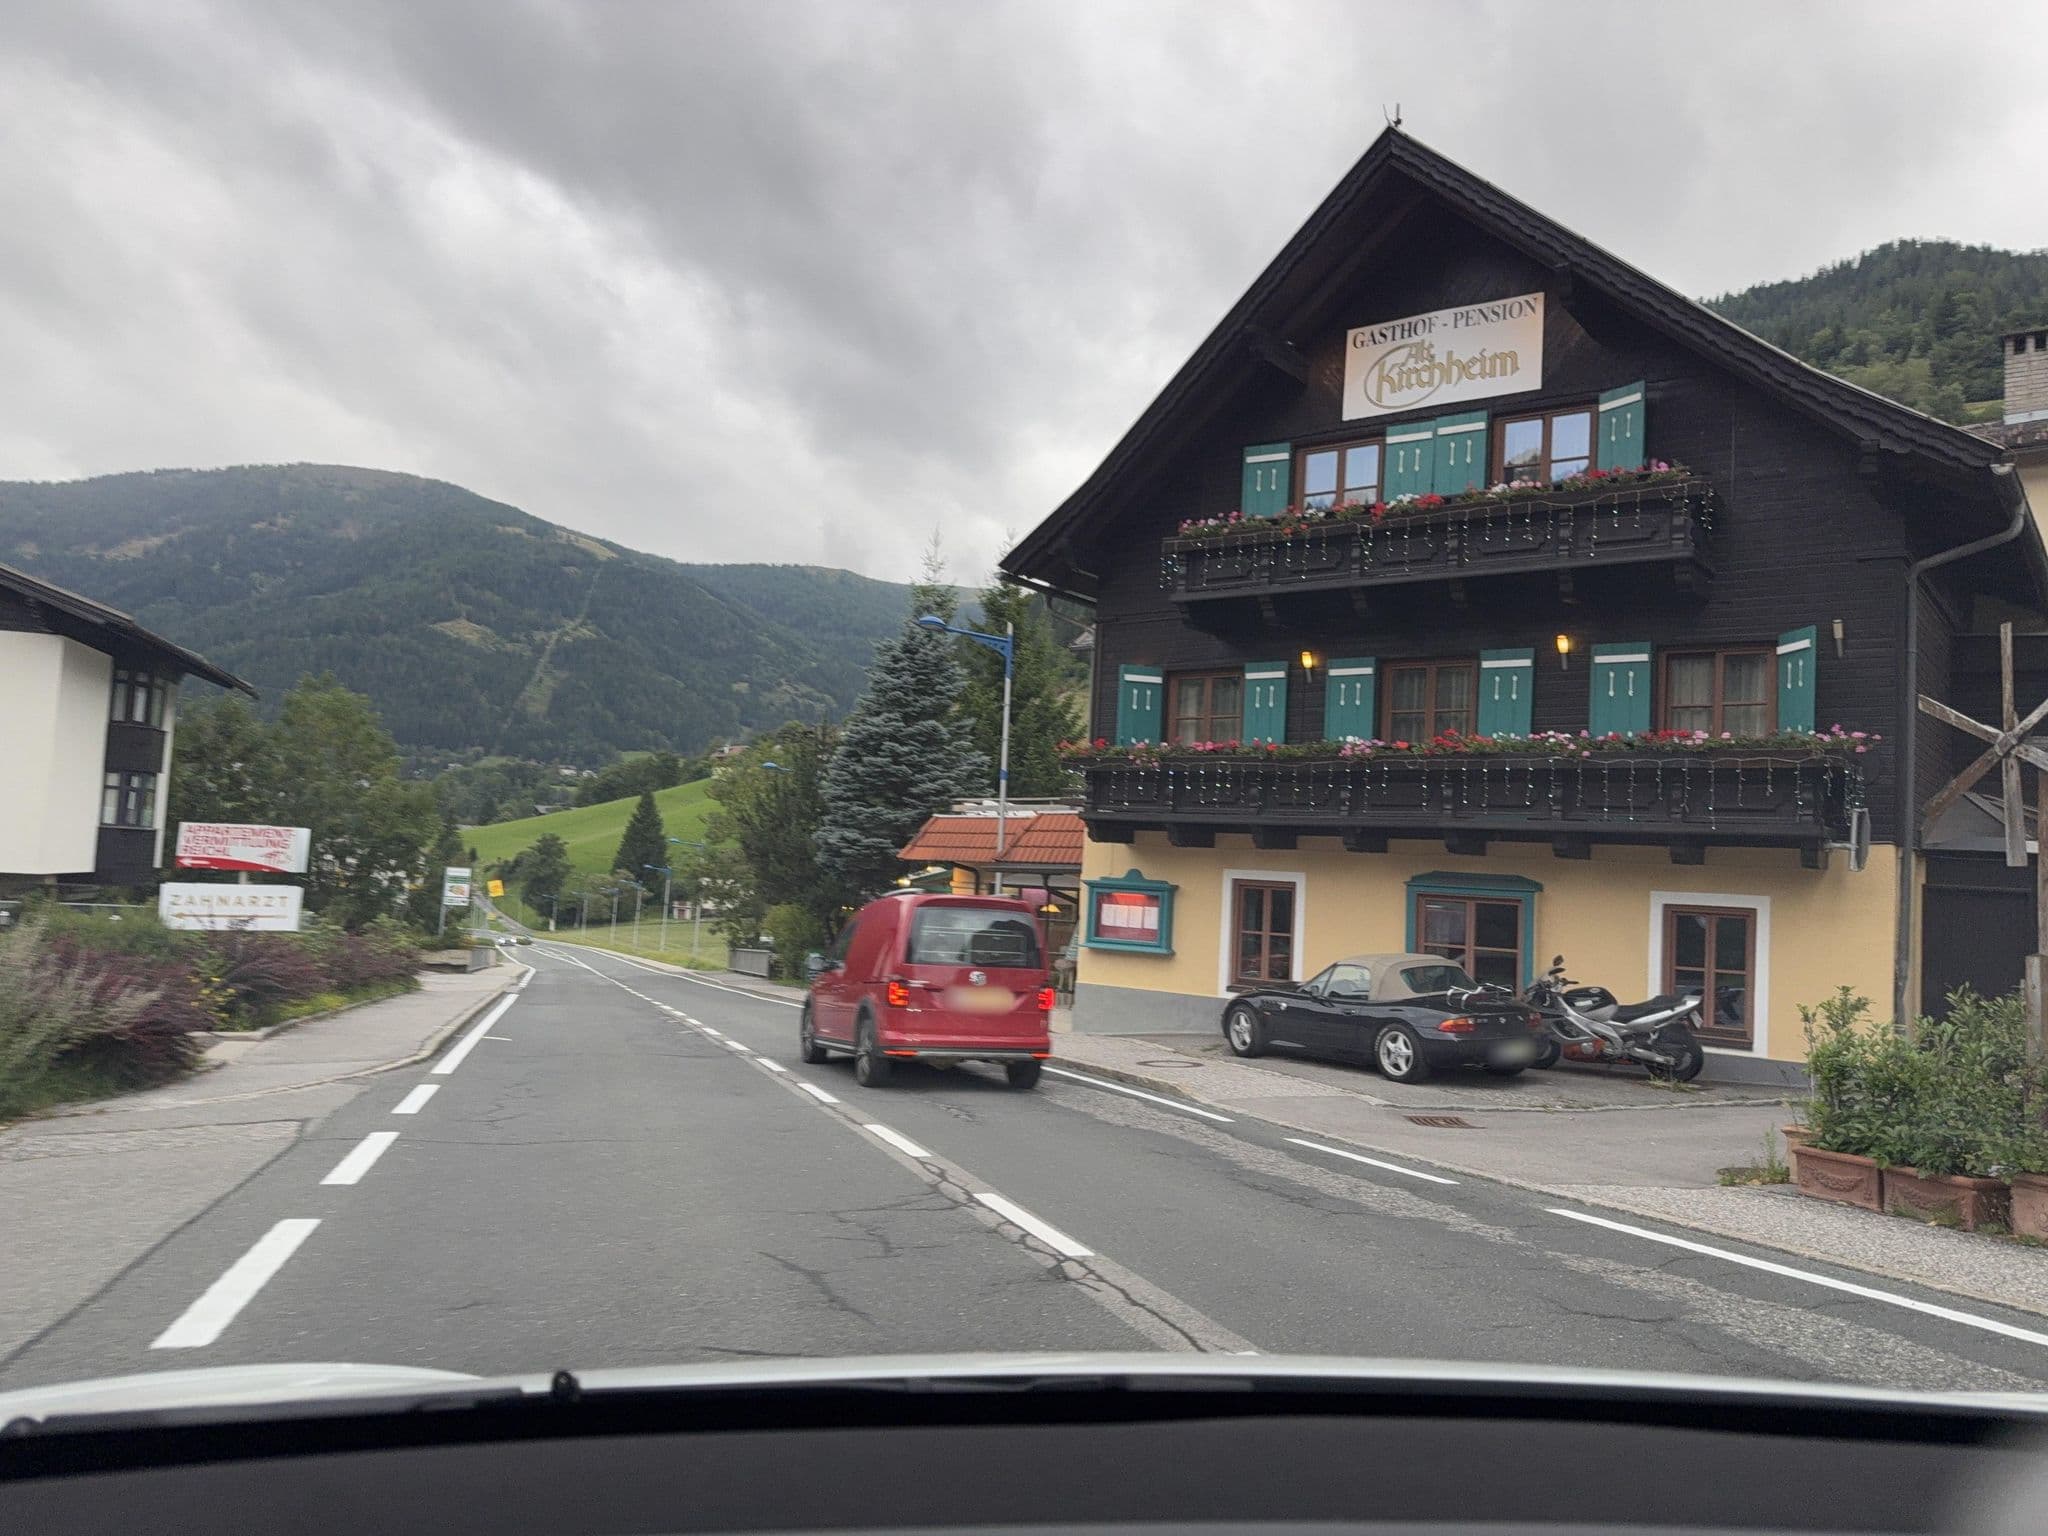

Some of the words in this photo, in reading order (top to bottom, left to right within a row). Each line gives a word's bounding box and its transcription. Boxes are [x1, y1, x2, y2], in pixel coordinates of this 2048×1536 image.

[1353, 315, 1438, 349] GASTHOF
[1453, 298, 1538, 329] PENSION
[1376, 347, 1520, 403] Kirchheim
[169, 894, 289, 907] ZAHNARZT
